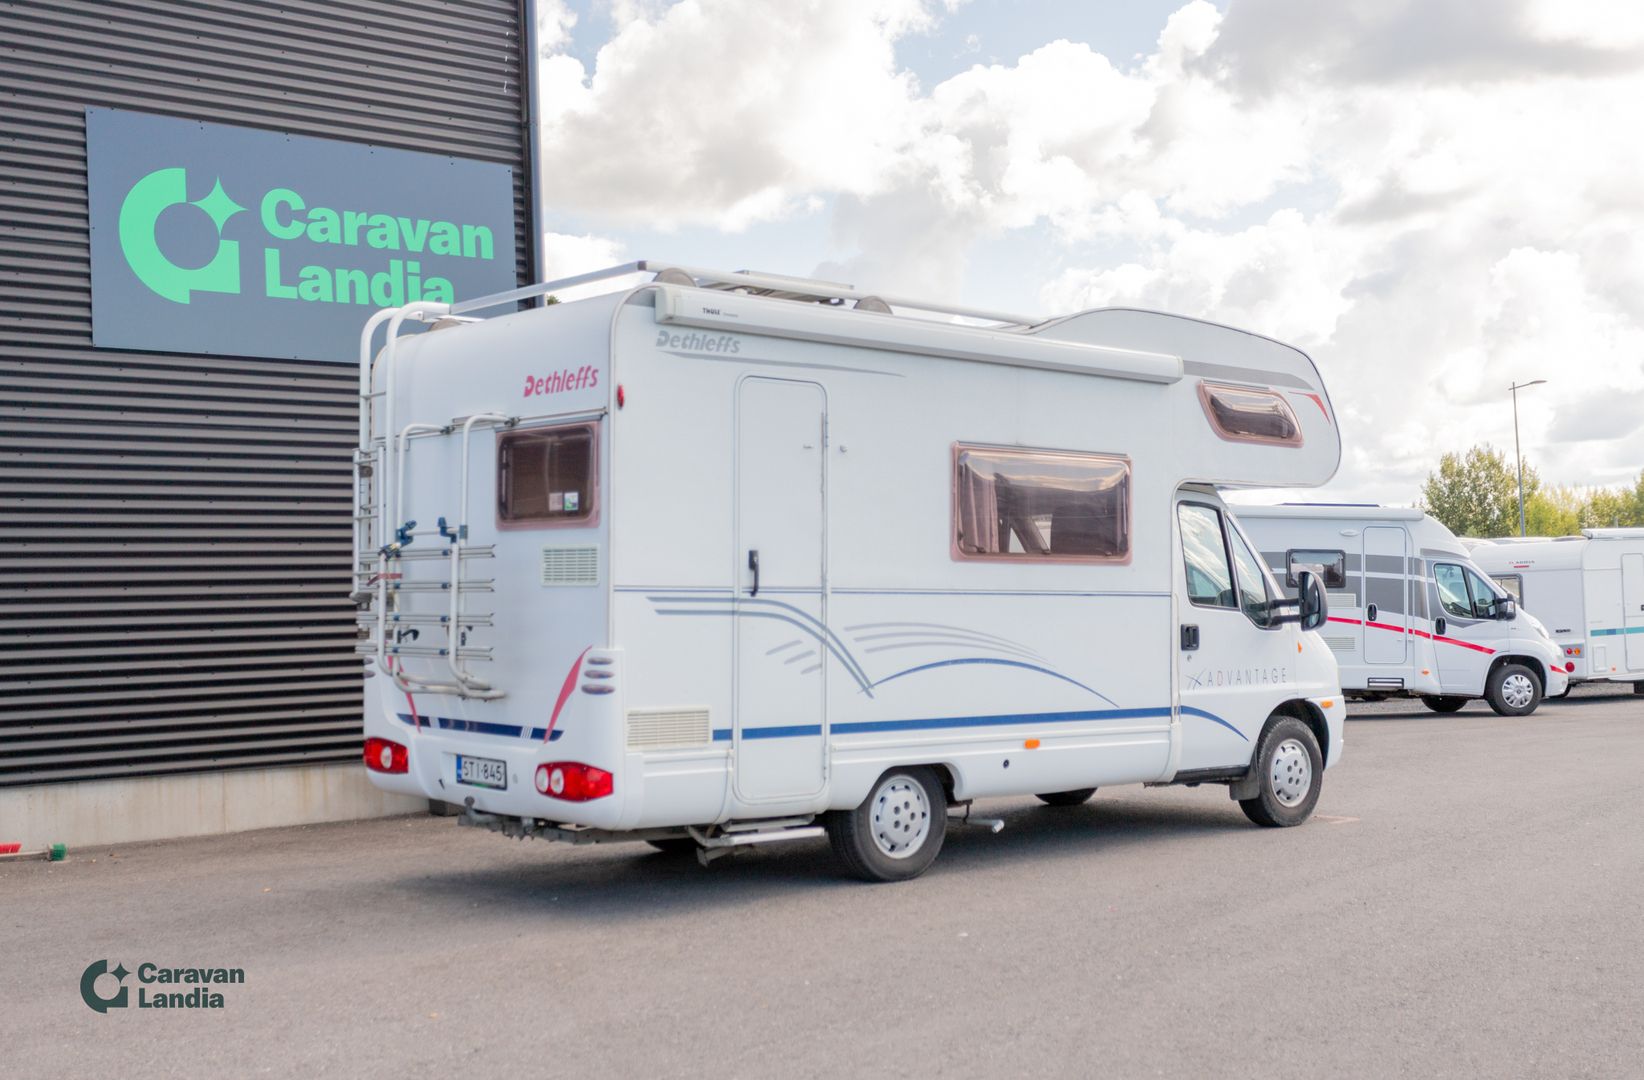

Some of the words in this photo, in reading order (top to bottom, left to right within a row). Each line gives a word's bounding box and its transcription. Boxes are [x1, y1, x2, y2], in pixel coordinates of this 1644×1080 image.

[260, 188, 494, 260] Caravan
[264, 248, 455, 308] Landia
[655, 330, 741, 354] Dethleffs
[524, 364, 599, 398] Dethleffs
